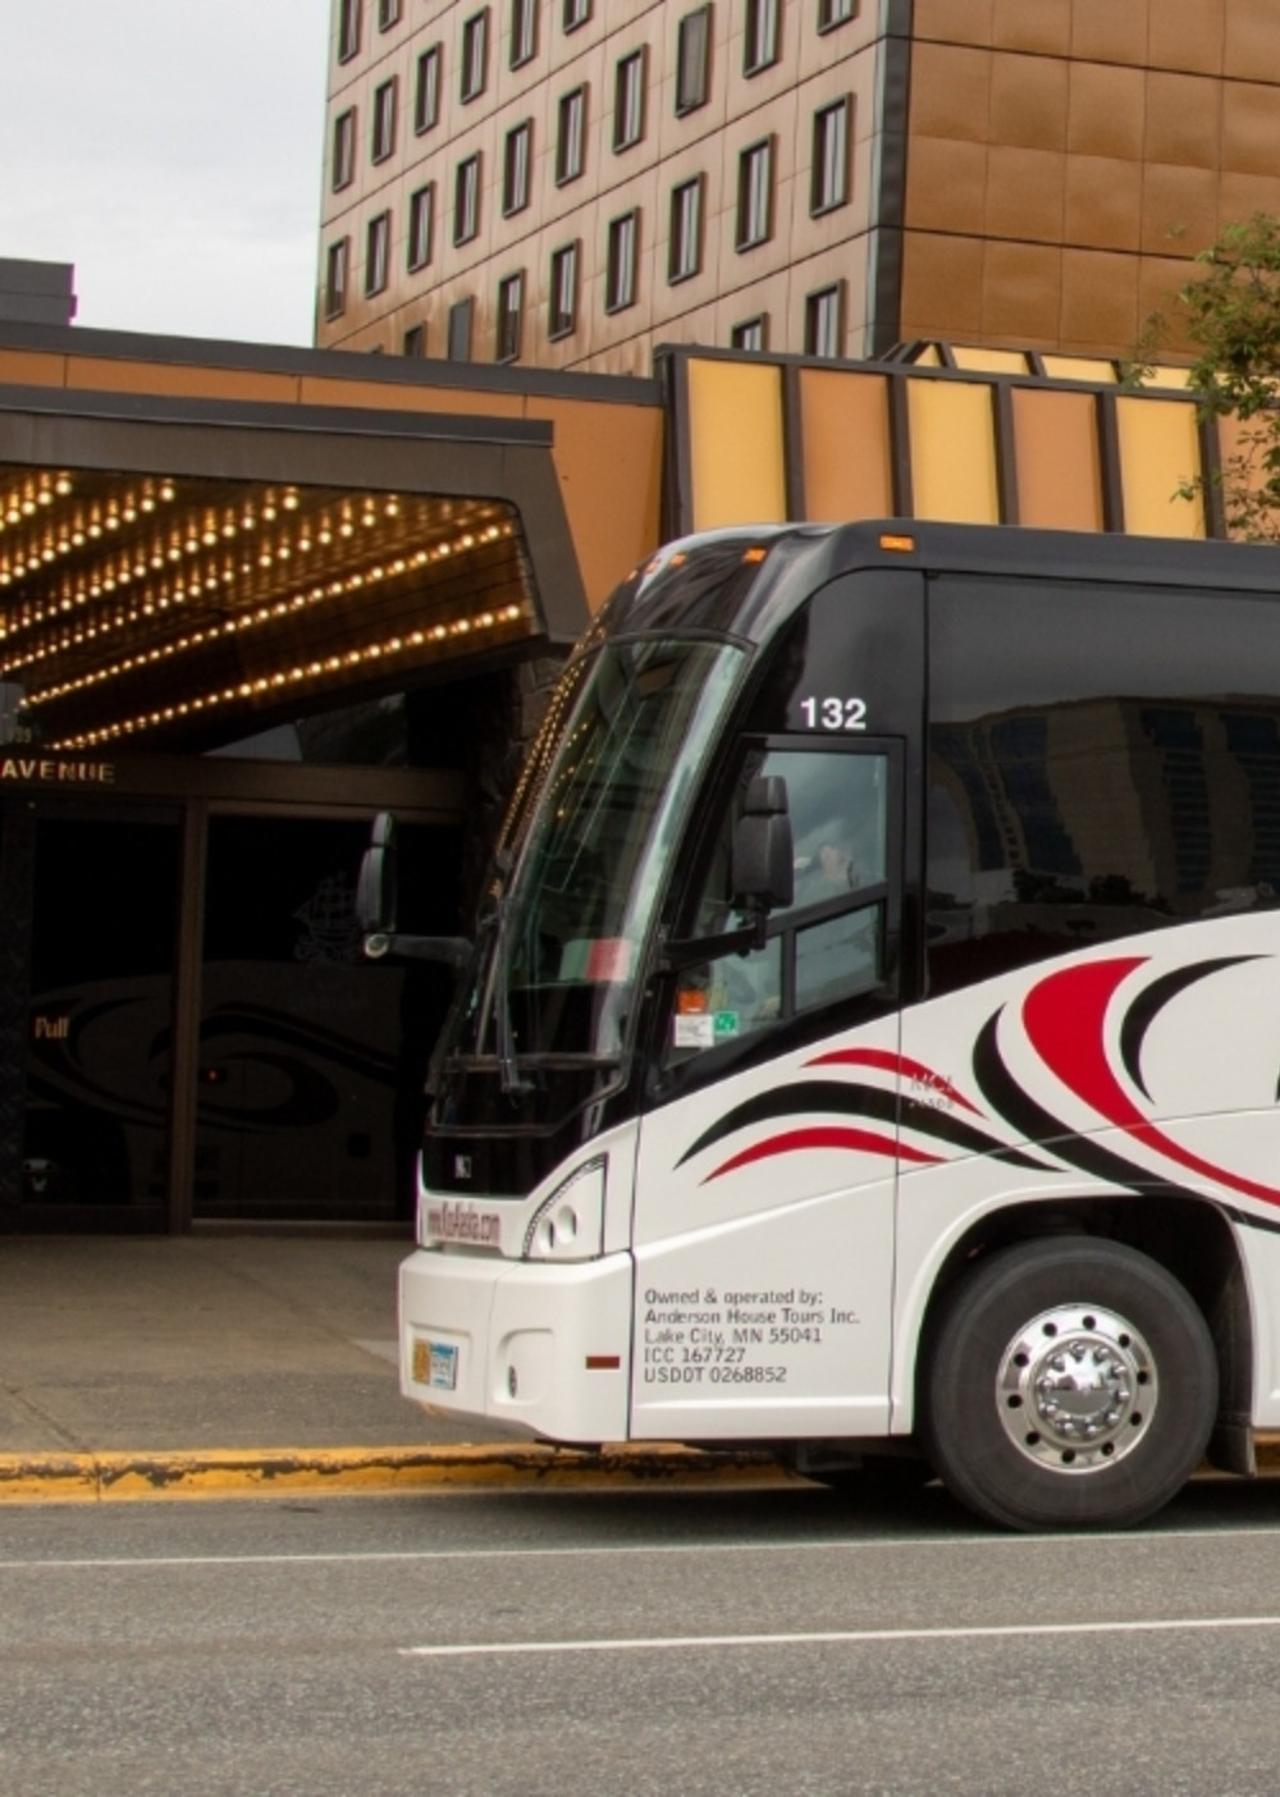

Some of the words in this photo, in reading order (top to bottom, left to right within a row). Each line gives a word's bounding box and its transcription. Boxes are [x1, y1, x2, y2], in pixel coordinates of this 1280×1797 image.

[801, 696, 866, 730] 132
[1, 759, 115, 783] AVENUE
[35, 1016, 68, 1038] Pull
[645, 1289, 699, 1304] Owned
[704, 1289, 718, 1304] &
[724, 1289, 794, 1305] operated
[800, 1289, 823, 1306] by:
[645, 1309, 720, 1324] Anderson
[727, 1309, 776, 1324] House
[781, 1308, 824, 1324] Tours
[831, 1308, 860, 1324] Inc.
[645, 1328, 684, 1343] Lake
[732, 1328, 763, 1343] MN
[769, 1328, 822, 1343] 55041
[645, 1348, 674, 1362] ICC
[682, 1348, 746, 1362] 167727
[645, 1367, 704, 1382] USDOT
[710, 1367, 787, 1382] 0268852
